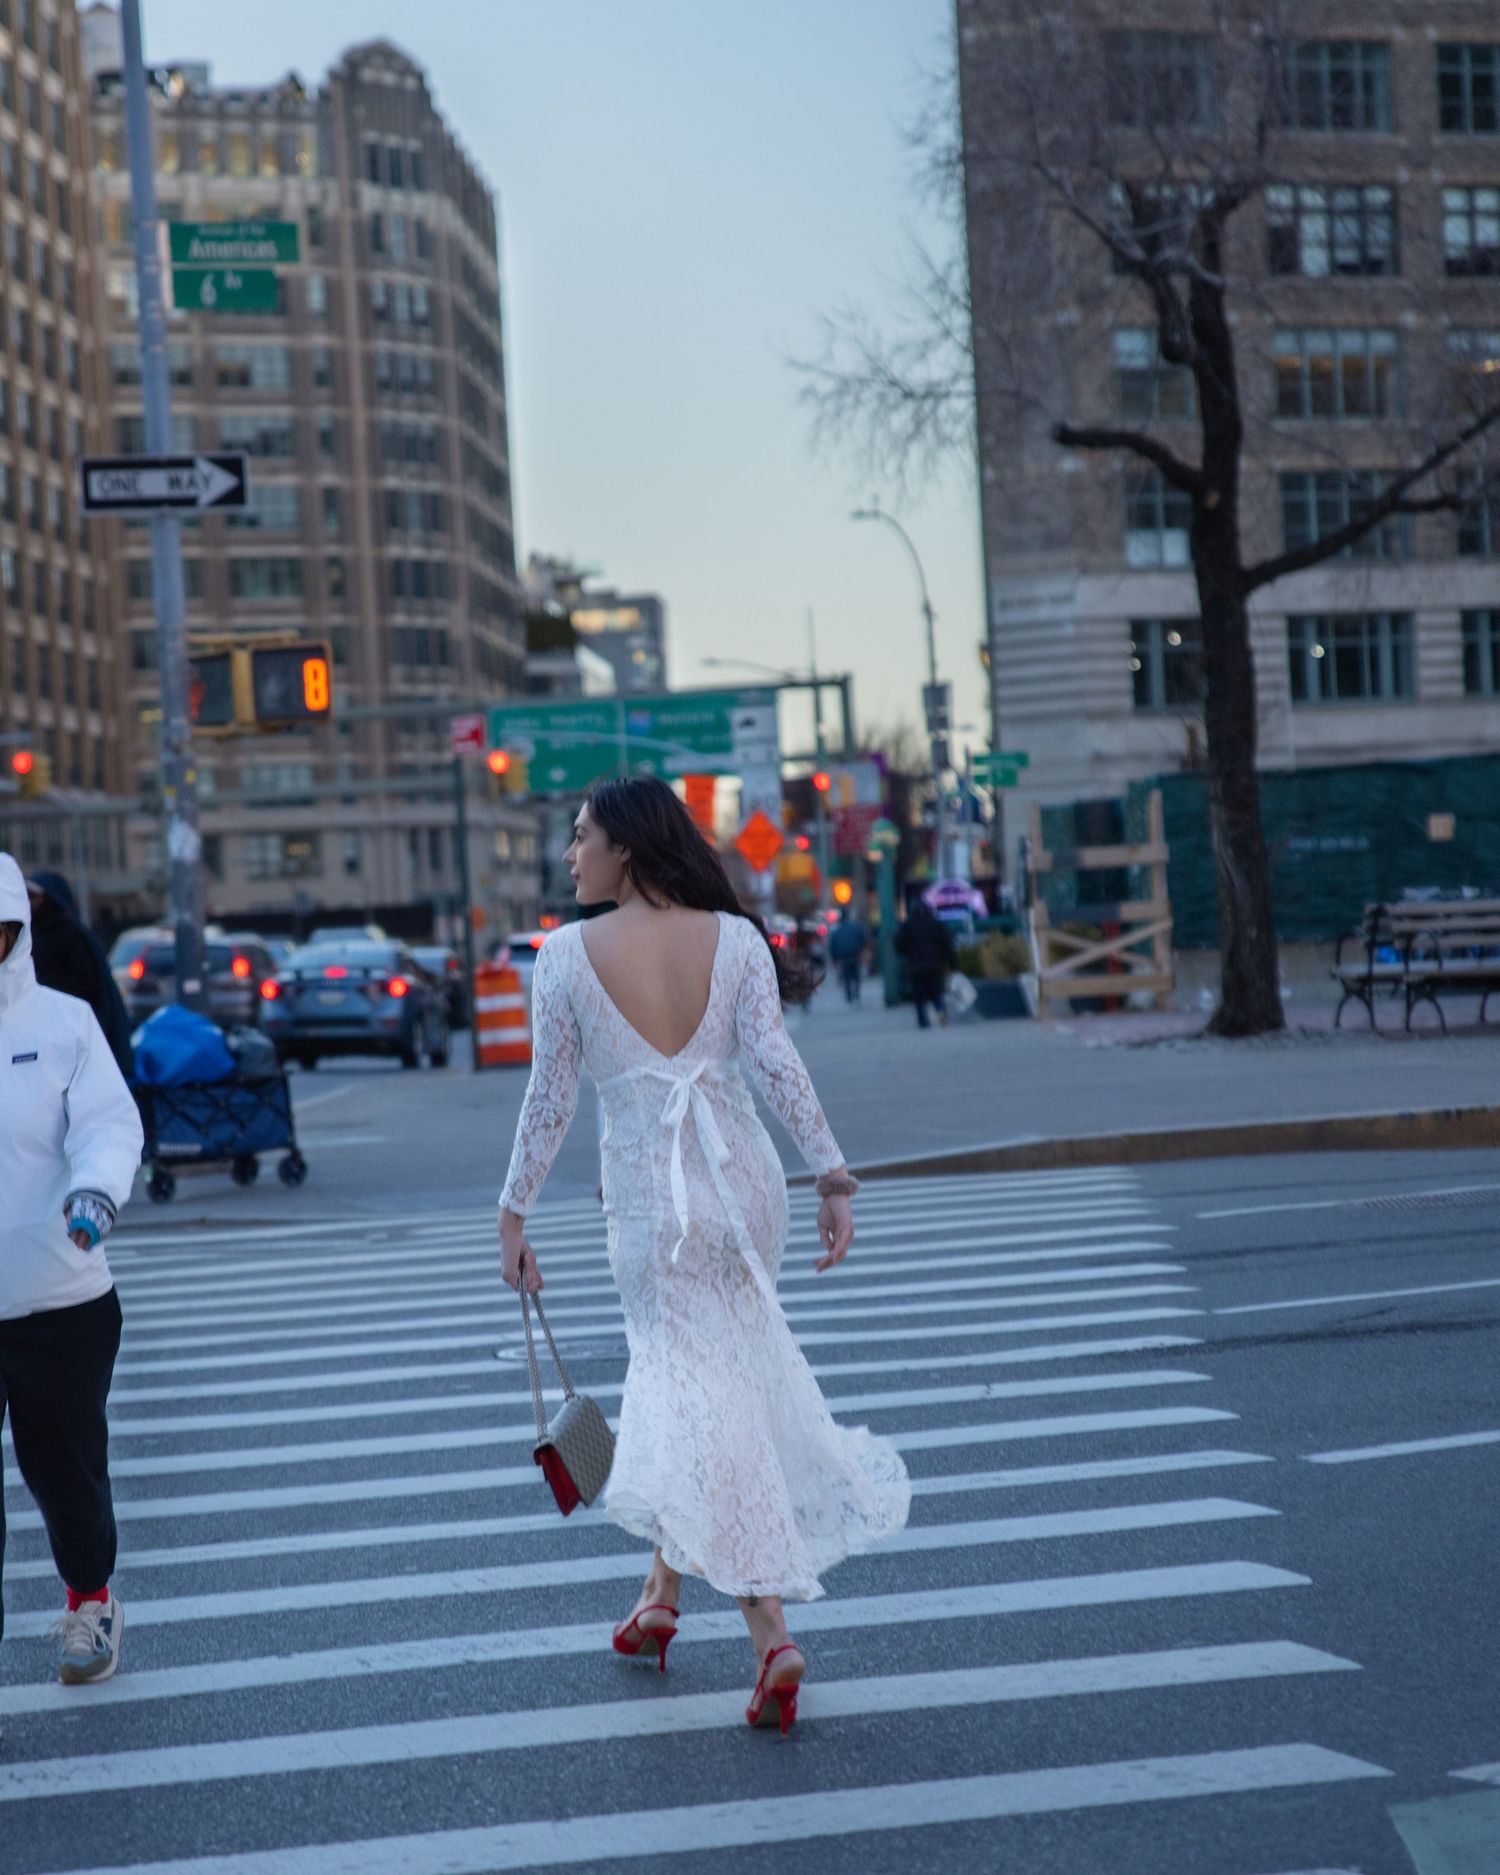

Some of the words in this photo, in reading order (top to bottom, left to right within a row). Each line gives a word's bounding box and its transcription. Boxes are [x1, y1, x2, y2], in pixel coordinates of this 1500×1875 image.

[188, 237, 278, 259] Americas
[200, 272, 217, 305] 6
[99, 470, 141, 493] ONE
[167, 467, 214, 491] WAY
[303, 657, 329, 711] 8
